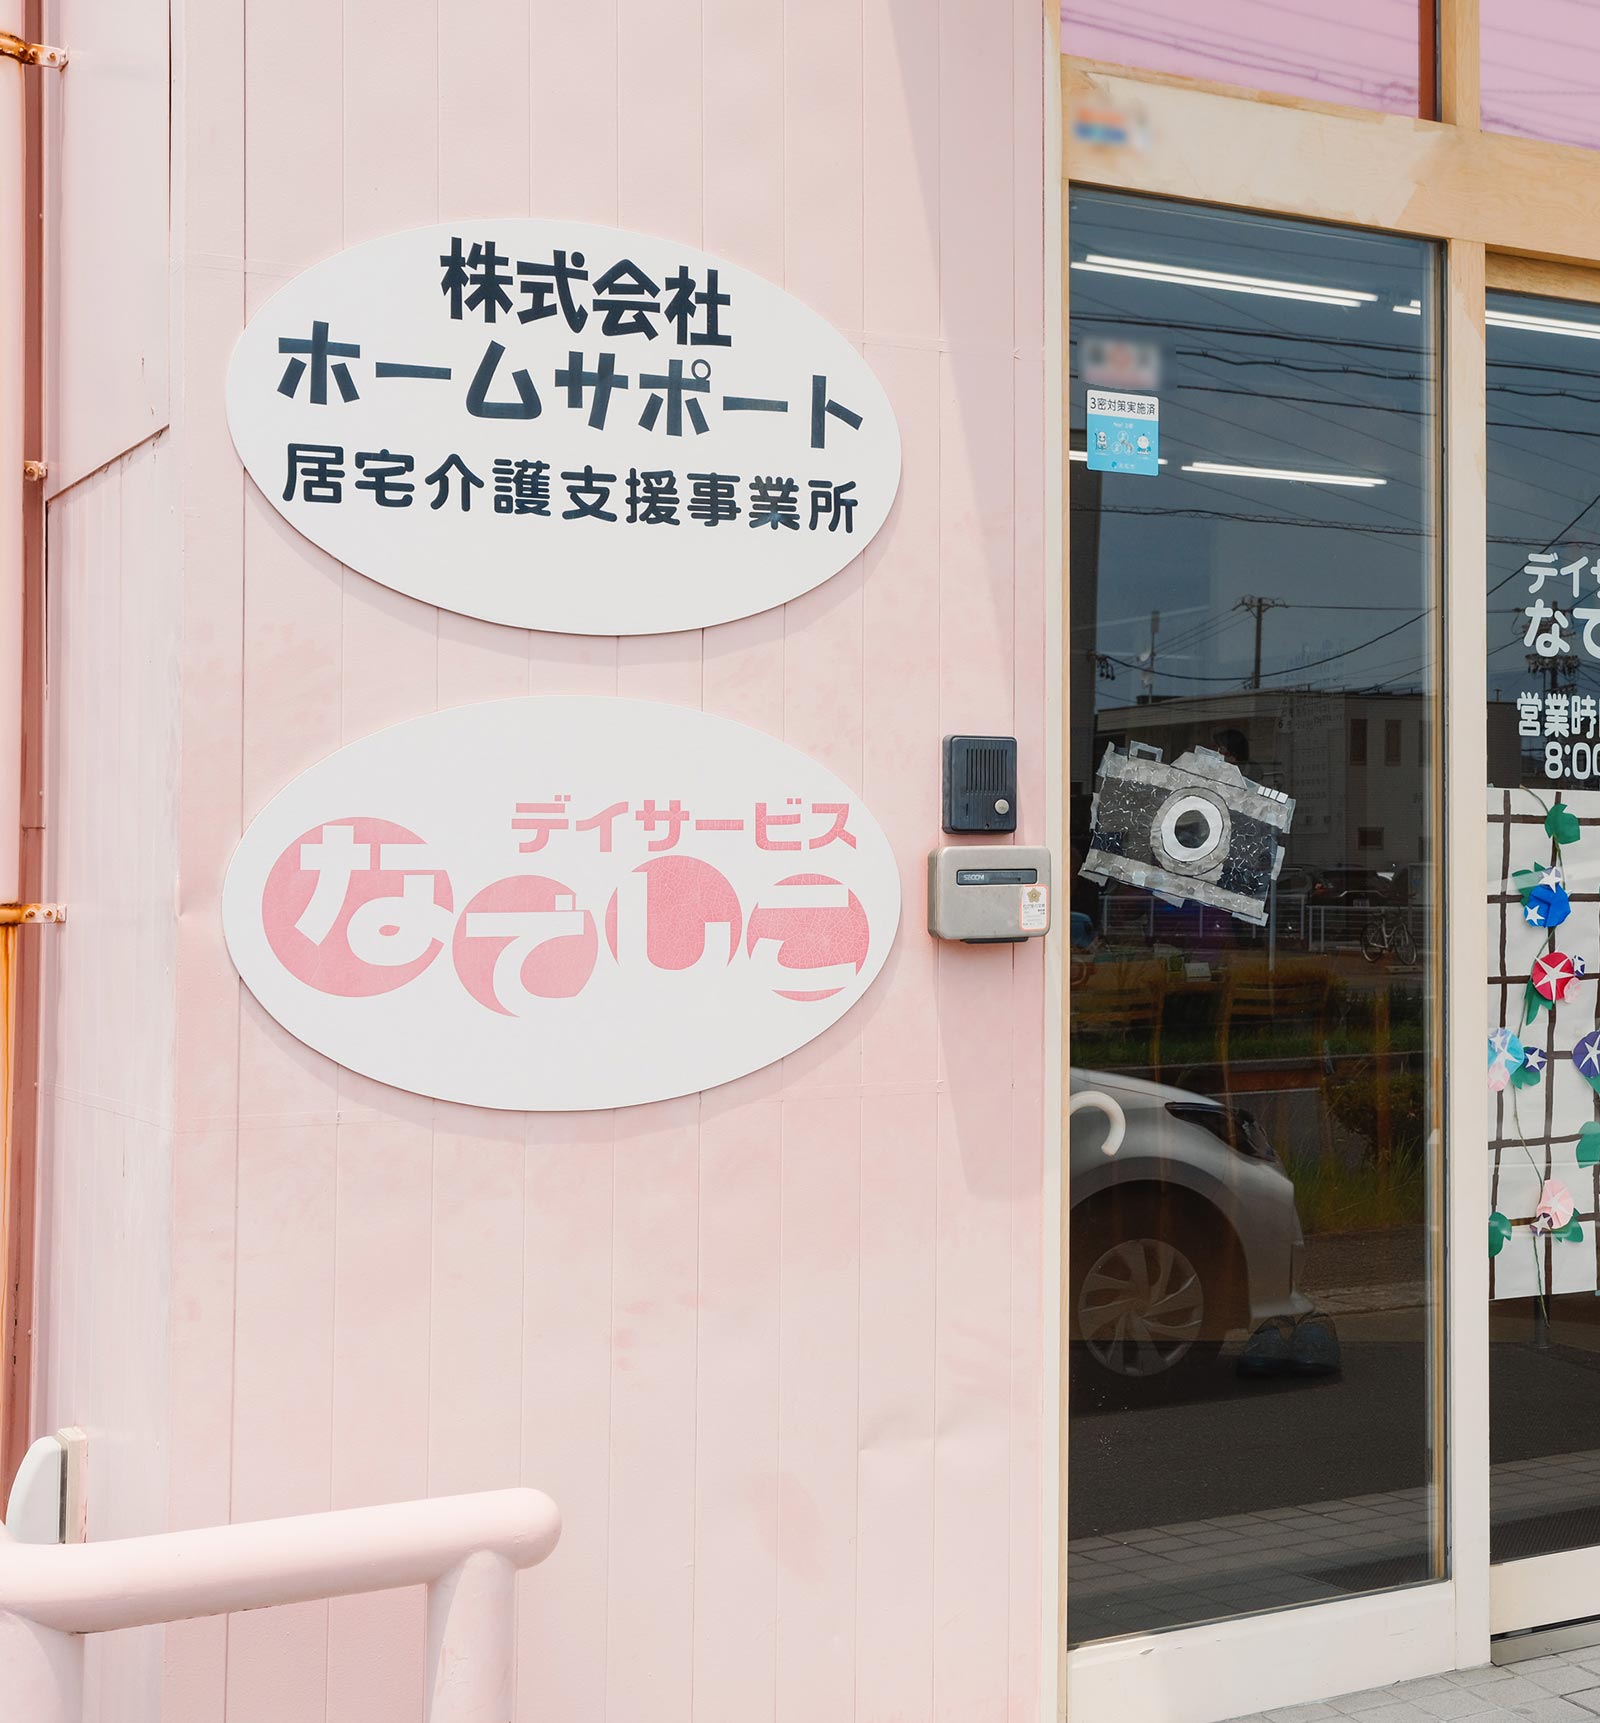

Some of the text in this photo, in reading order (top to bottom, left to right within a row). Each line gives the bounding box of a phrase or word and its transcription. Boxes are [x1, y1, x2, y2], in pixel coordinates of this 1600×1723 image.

[439, 236, 732, 348] 株式会社
[276, 320, 864, 449] ホームサポート
[1090, 397, 1156, 416] 3密対策実施済
[282, 442, 860, 534] 居宅介護支援事業所
[511, 793, 858, 854] デイサービス
[262, 816, 871, 1018] なでしこ
